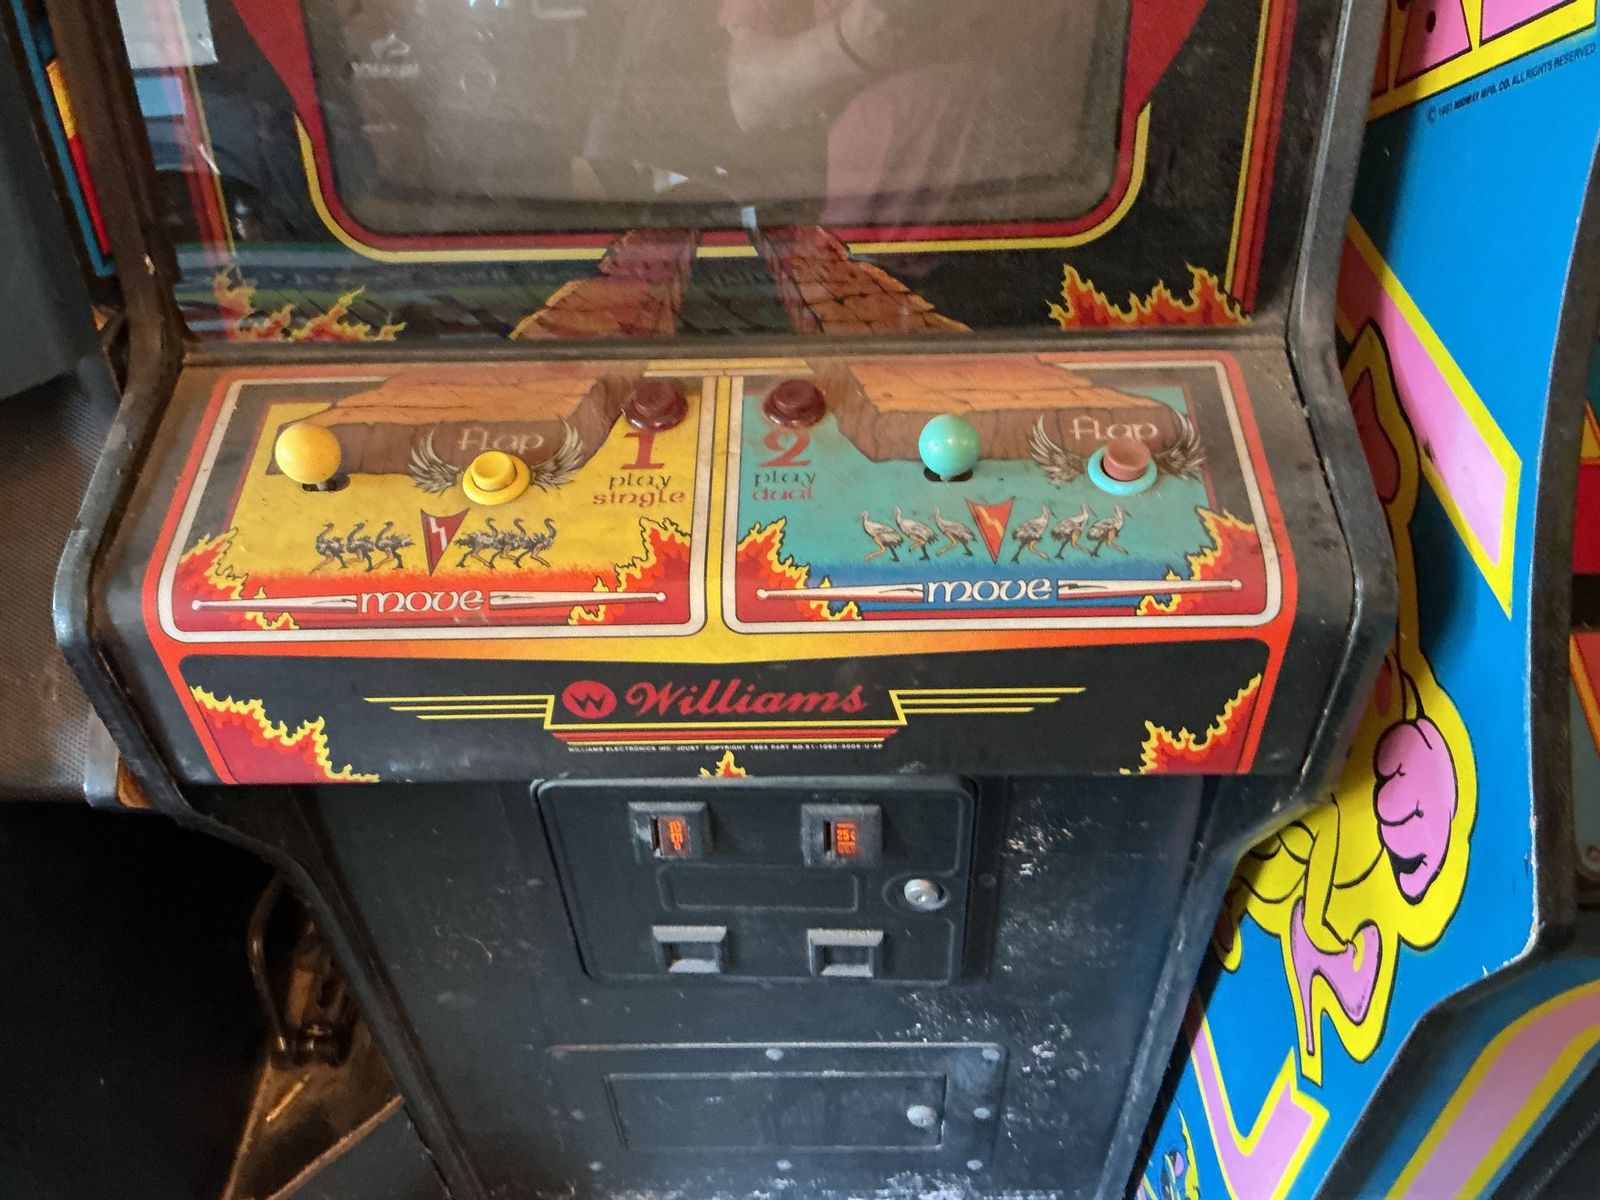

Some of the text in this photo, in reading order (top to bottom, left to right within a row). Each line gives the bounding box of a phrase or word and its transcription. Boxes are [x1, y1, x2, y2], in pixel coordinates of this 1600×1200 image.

[1511, 73, 1525, 86] ALL
[1525, 59, 1553, 81] RIGHTS
[1553, 42, 1596, 69] RESERVED
[620, 431, 665, 471] 1
[757, 430, 813, 468] 2
[609, 473, 672, 491] play
[754, 470, 817, 488] play
[592, 488, 686, 507] single
[361, 590, 484, 614] move
[928, 578, 1053, 603] move
[625, 678, 868, 717] Williams
